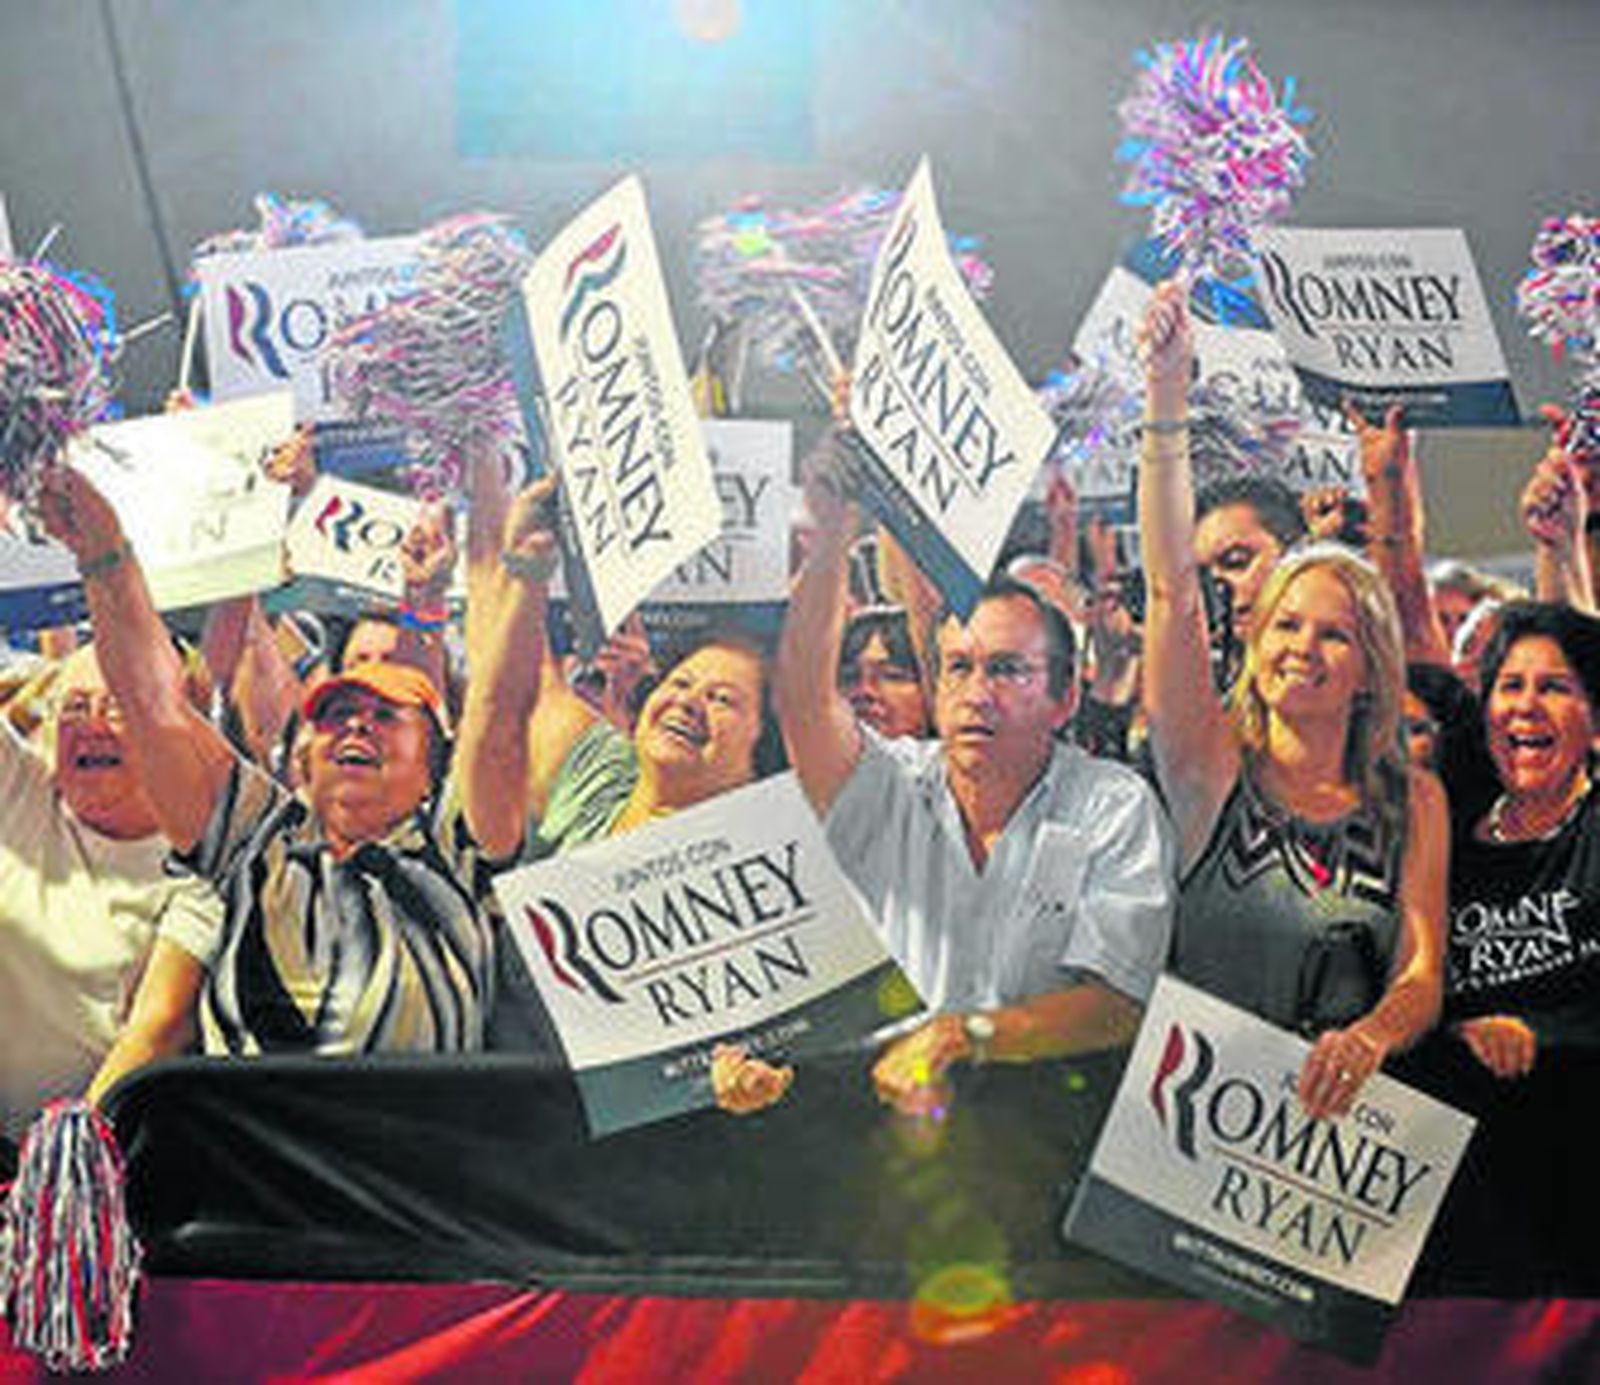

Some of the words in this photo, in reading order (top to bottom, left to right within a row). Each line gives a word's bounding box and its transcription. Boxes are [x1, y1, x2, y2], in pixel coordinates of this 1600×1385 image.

[868, 202, 1014, 486] ROMNEY
[1260, 252, 1465, 338] ROMNEY
[1335, 332, 1455, 370] RYAN
[559, 222, 674, 552] ROMNEY
[858, 353, 958, 513] RYAN
[523, 841, 812, 1004] ROMNEY
[647, 935, 811, 1026] RYAN
[1150, 1022, 1431, 1216] ROMNEY
[1212, 1165, 1368, 1265] RYAN
